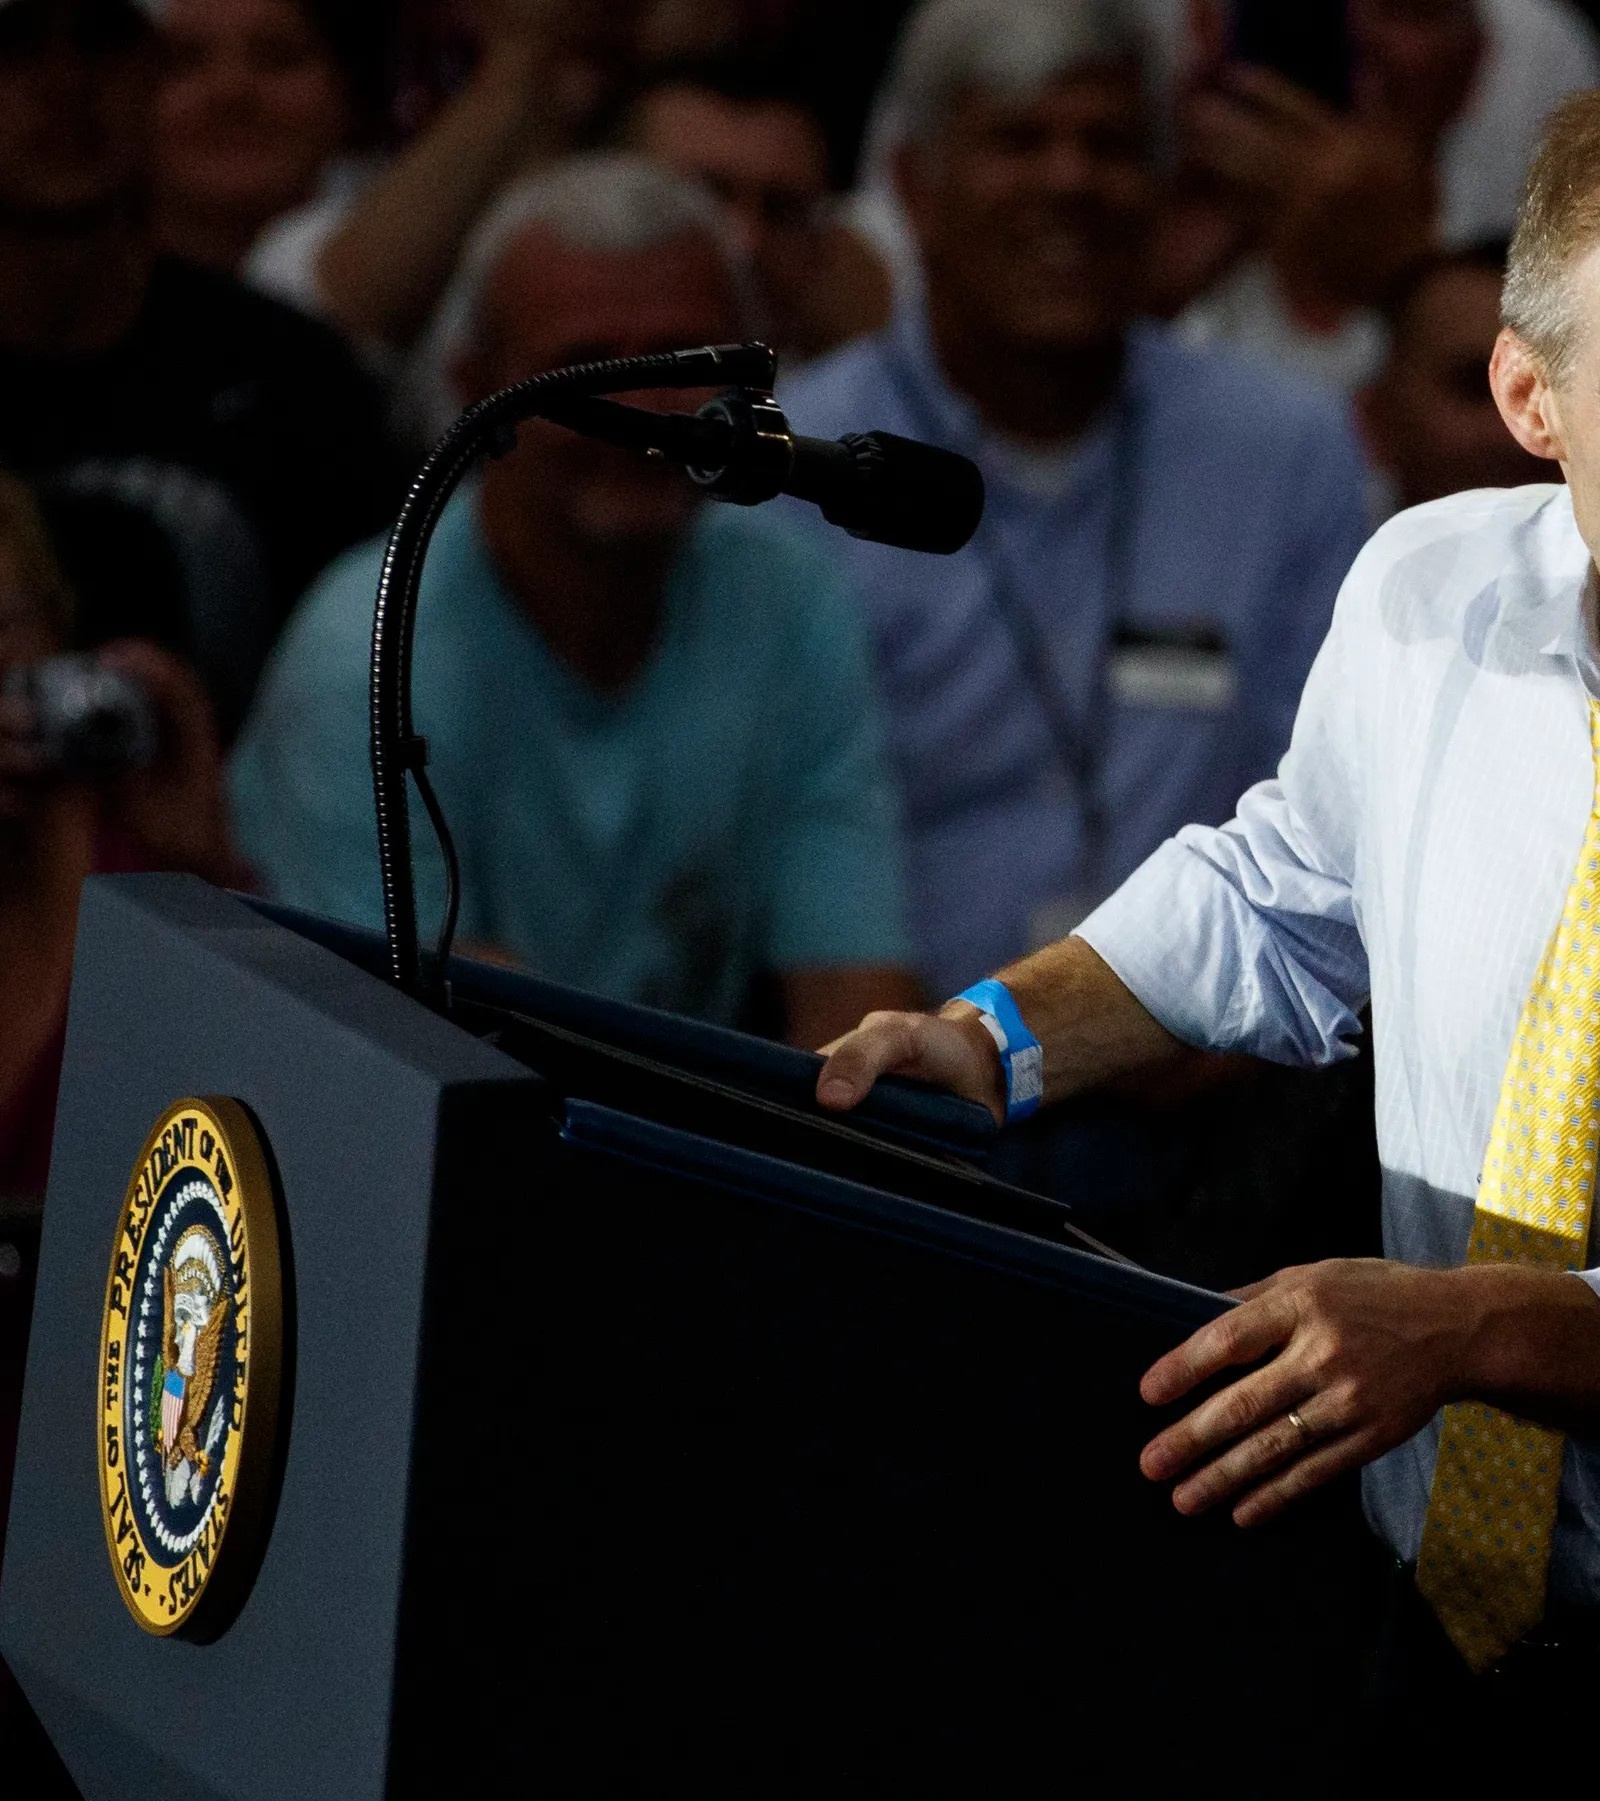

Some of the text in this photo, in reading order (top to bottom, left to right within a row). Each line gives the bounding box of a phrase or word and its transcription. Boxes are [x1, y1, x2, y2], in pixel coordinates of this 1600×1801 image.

[199, 1129, 215, 1163] OF
[110, 1117, 198, 1320] PRESIDENT
[106, 1340, 120, 1411] THE
[230, 1207, 247, 1432] UNITED
[106, 1424, 119, 1468] OF
[109, 1471, 145, 1593] SEAL
[168, 1477, 229, 1616] STATES
